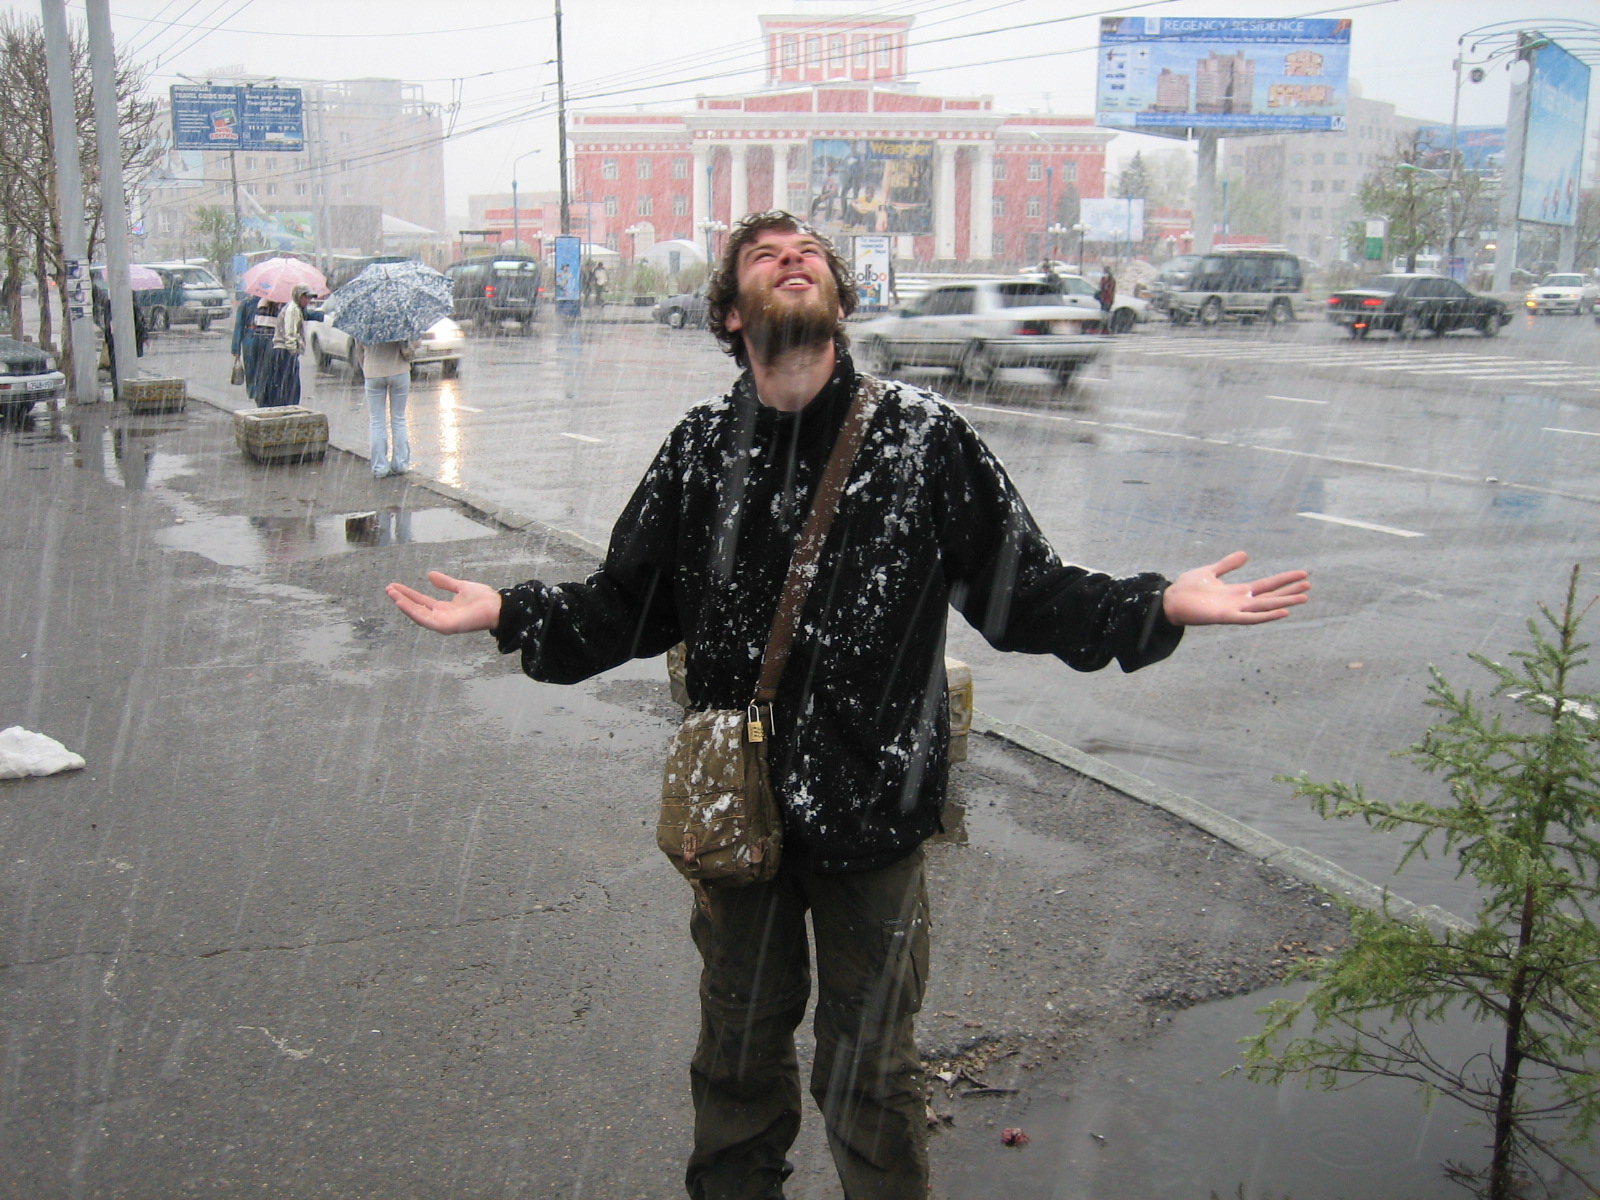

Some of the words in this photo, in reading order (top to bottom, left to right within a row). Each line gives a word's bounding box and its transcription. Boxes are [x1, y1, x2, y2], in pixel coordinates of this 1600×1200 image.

[1163, 19, 1227, 31] REGENCY
[1232, 20, 1304, 32] RESIDENCE
[871, 141, 932, 158] Wrangler
